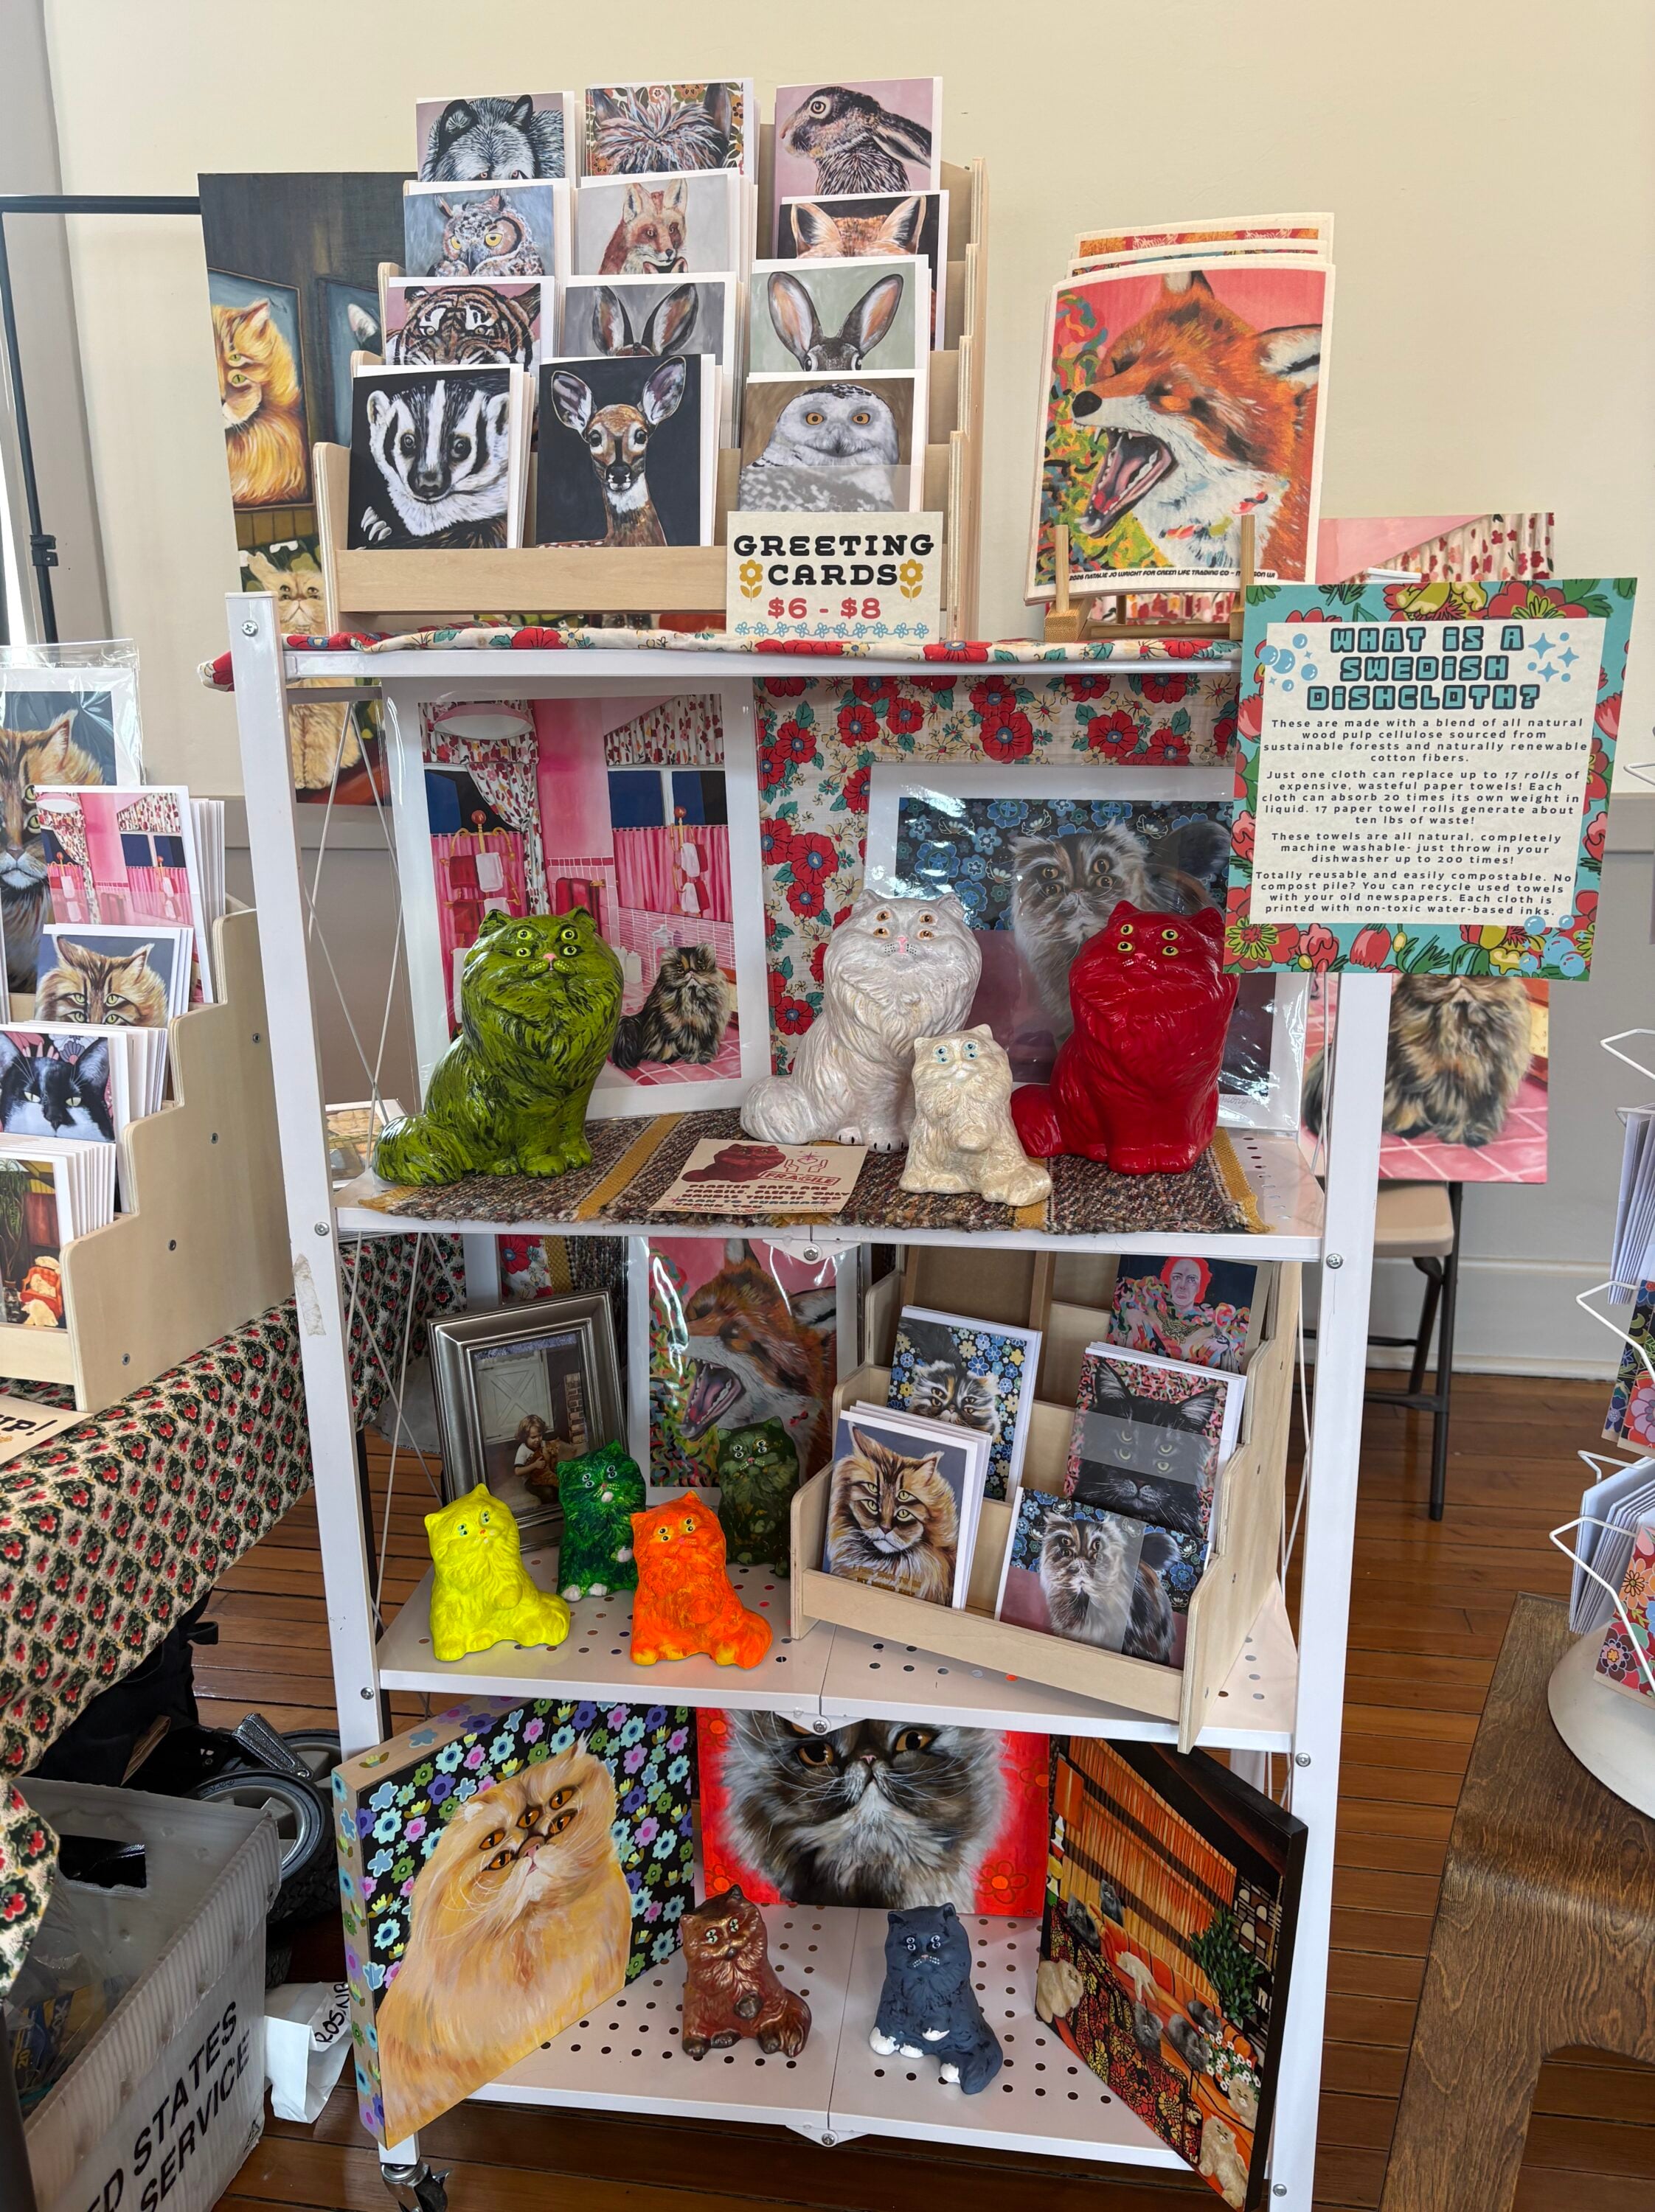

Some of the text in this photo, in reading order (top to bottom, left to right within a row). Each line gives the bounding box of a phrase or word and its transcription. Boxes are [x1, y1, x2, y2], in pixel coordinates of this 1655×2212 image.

[734, 534, 934, 557] GREETING
[768, 564, 898, 585] CARDS
[768, 597, 808, 619] $6
[840, 597, 881, 619] $8
[1330, 627, 1426, 653] WHAT
[1500, 625, 1524, 650] A
[1271, 719, 1311, 728] These
[1345, 718, 1380, 727] made
[1387, 718, 1416, 727] with
[1436, 718, 1475, 727] blend
[1482, 718, 1496, 727] of
[1502, 718, 1521, 727] all
[1528, 718, 1583, 727] natural
[1302, 730, 1546, 741] wood pulp cellulose sourced from
[1263, 742, 1587, 752] sustainable forests and naturally renewable
[1423, 753, 1468, 762] fibers.
[1266, 771, 1295, 779] Just
[1331, 770, 1366, 779] cloth
[1402, 770, 1454, 780] replace
[1460, 772, 1477, 781] up
[1505, 772, 1518, 780] 17
[1524, 771, 1558, 779] rolls
[1565, 771, 1580, 779] of
[1279, 781, 1562, 792] expensive, wasteful paper towels! Each
[1262, 793, 1296, 802] cloth
[1330, 793, 1377, 801] absorb
[1406, 793, 1445, 801] times
[1451, 793, 1469, 801] its
[1510, 793, 1559, 804] weight
[1566, 794, 1579, 803] in
[1266, 804, 1574, 815] liquid. 17 paper towel rolls generate about
[1356, 815, 1474, 824] ten lbs of waste!
[1271, 832, 1310, 841] These
[1316, 832, 1360, 841] towels
[1394, 832, 1412, 841] all
[1418, 832, 1474, 842] natural,
[1481, 833, 1561, 844] completely
[1280, 843, 1550, 855] machine washable- just throw in your
[1311, 854, 1389, 863] dishwasher
[1395, 856, 1411, 865] up
[1418, 855, 1431, 863] to
[1469, 855, 1513, 864] times!
[1255, 870, 1572, 883] Totally reusable and easily compostable. No
[1260, 883, 1316, 892] compost
[1322, 882, 1356, 891] pile?
[1421, 883, 1471, 892] recycle
[1477, 883, 1510, 892] used
[1516, 884, 1564, 893] towels
[1269, 892, 1552, 904] with your old newspapers. Each cloth is
[1265, 903, 1554, 916] printed with non-toxic water-based inks.
[764, 1172, 836, 1184] FRAGILE
[133, 2001, 237, 2176] STATES
[140, 2028, 249, 2212] SERVICE
